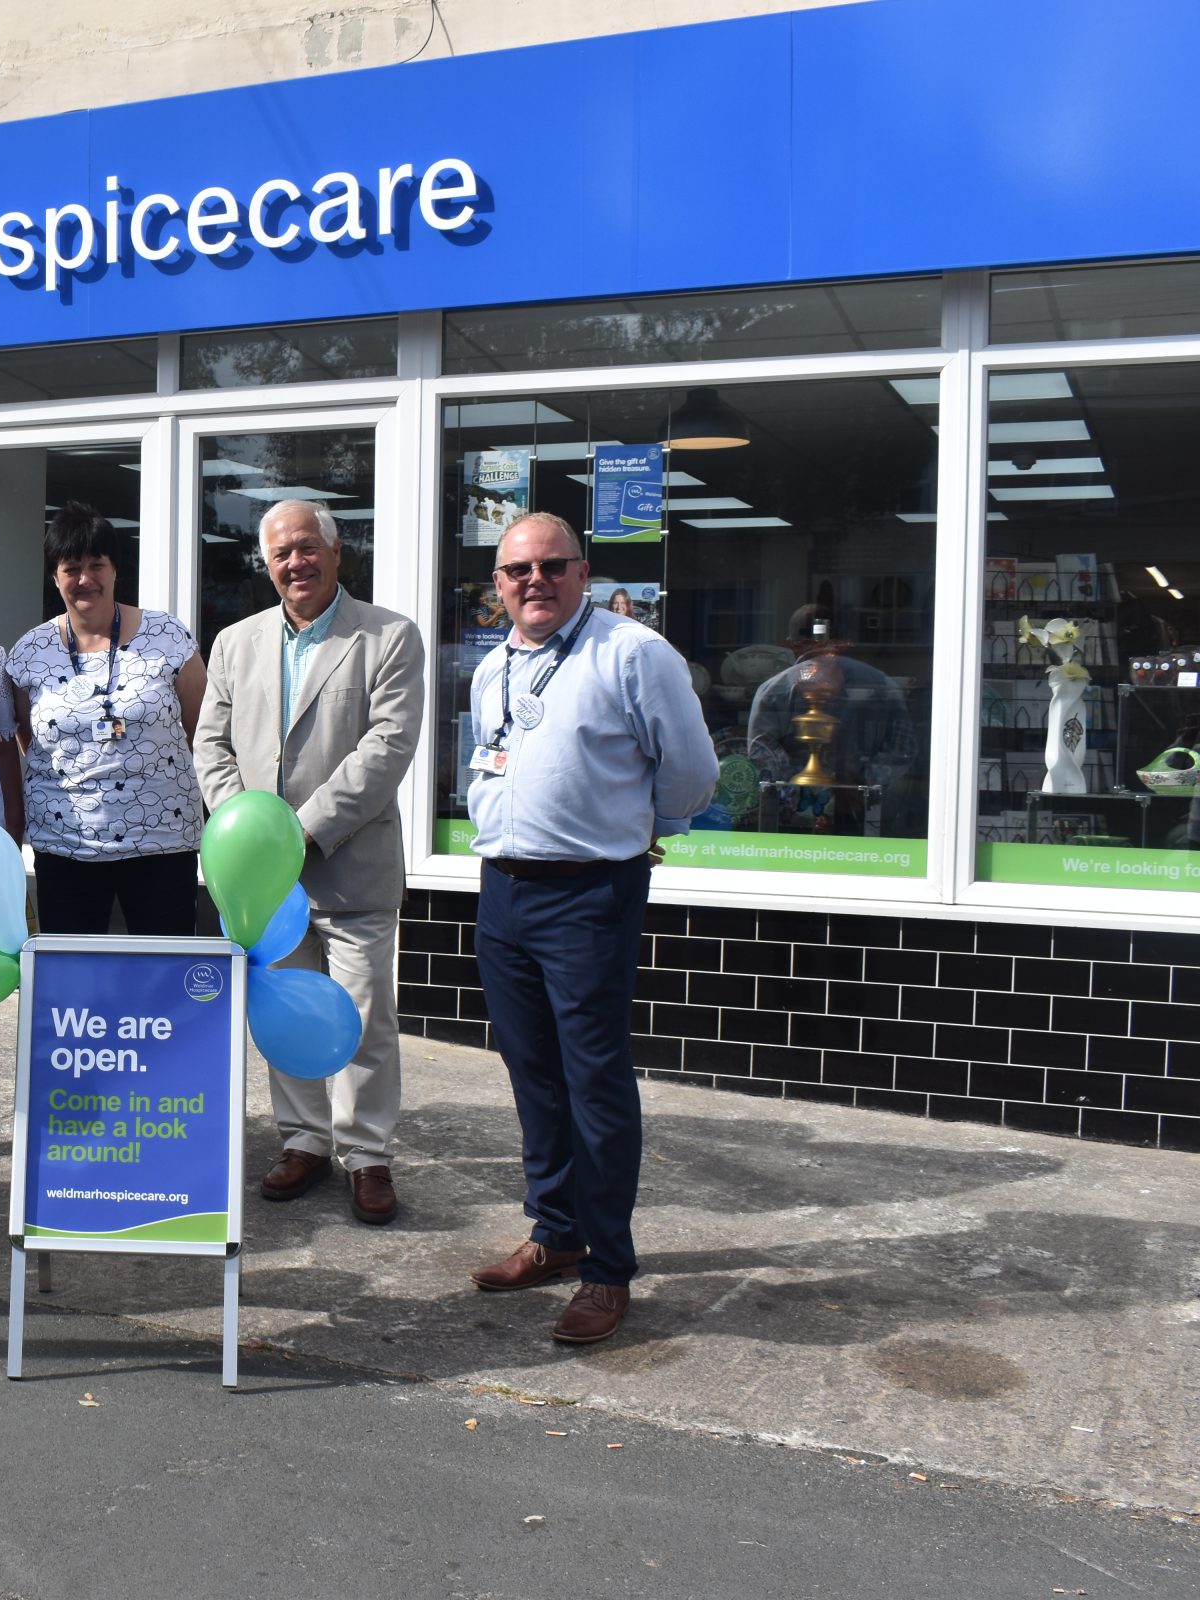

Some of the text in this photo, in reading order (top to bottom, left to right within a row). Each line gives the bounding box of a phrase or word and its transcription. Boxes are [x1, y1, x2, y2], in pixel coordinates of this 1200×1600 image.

[599, 458, 615, 466] Give
[627, 457, 639, 467] gift
[639, 457, 648, 465] of
[599, 465, 622, 473] hidden
[472, 471, 519, 485] CHALLENGE
[637, 503, 662, 513] Gift C
[482, 633, 504, 641] looking
[671, 841, 698, 857] day
[701, 842, 716, 855] at
[719, 844, 911, 868] weldmarhospicecare.org
[1062, 858, 1112, 874] We're
[1115, 860, 1180, 880] looking
[51, 1007, 173, 1040] We are
[50, 1047, 147, 1079] open.
[49, 1088, 205, 1114] Come in and
[48, 1114, 188, 1140] have a look
[47, 1142, 141, 1164] around!
[46, 1187, 190, 1205] weldmarhospicecare.org
